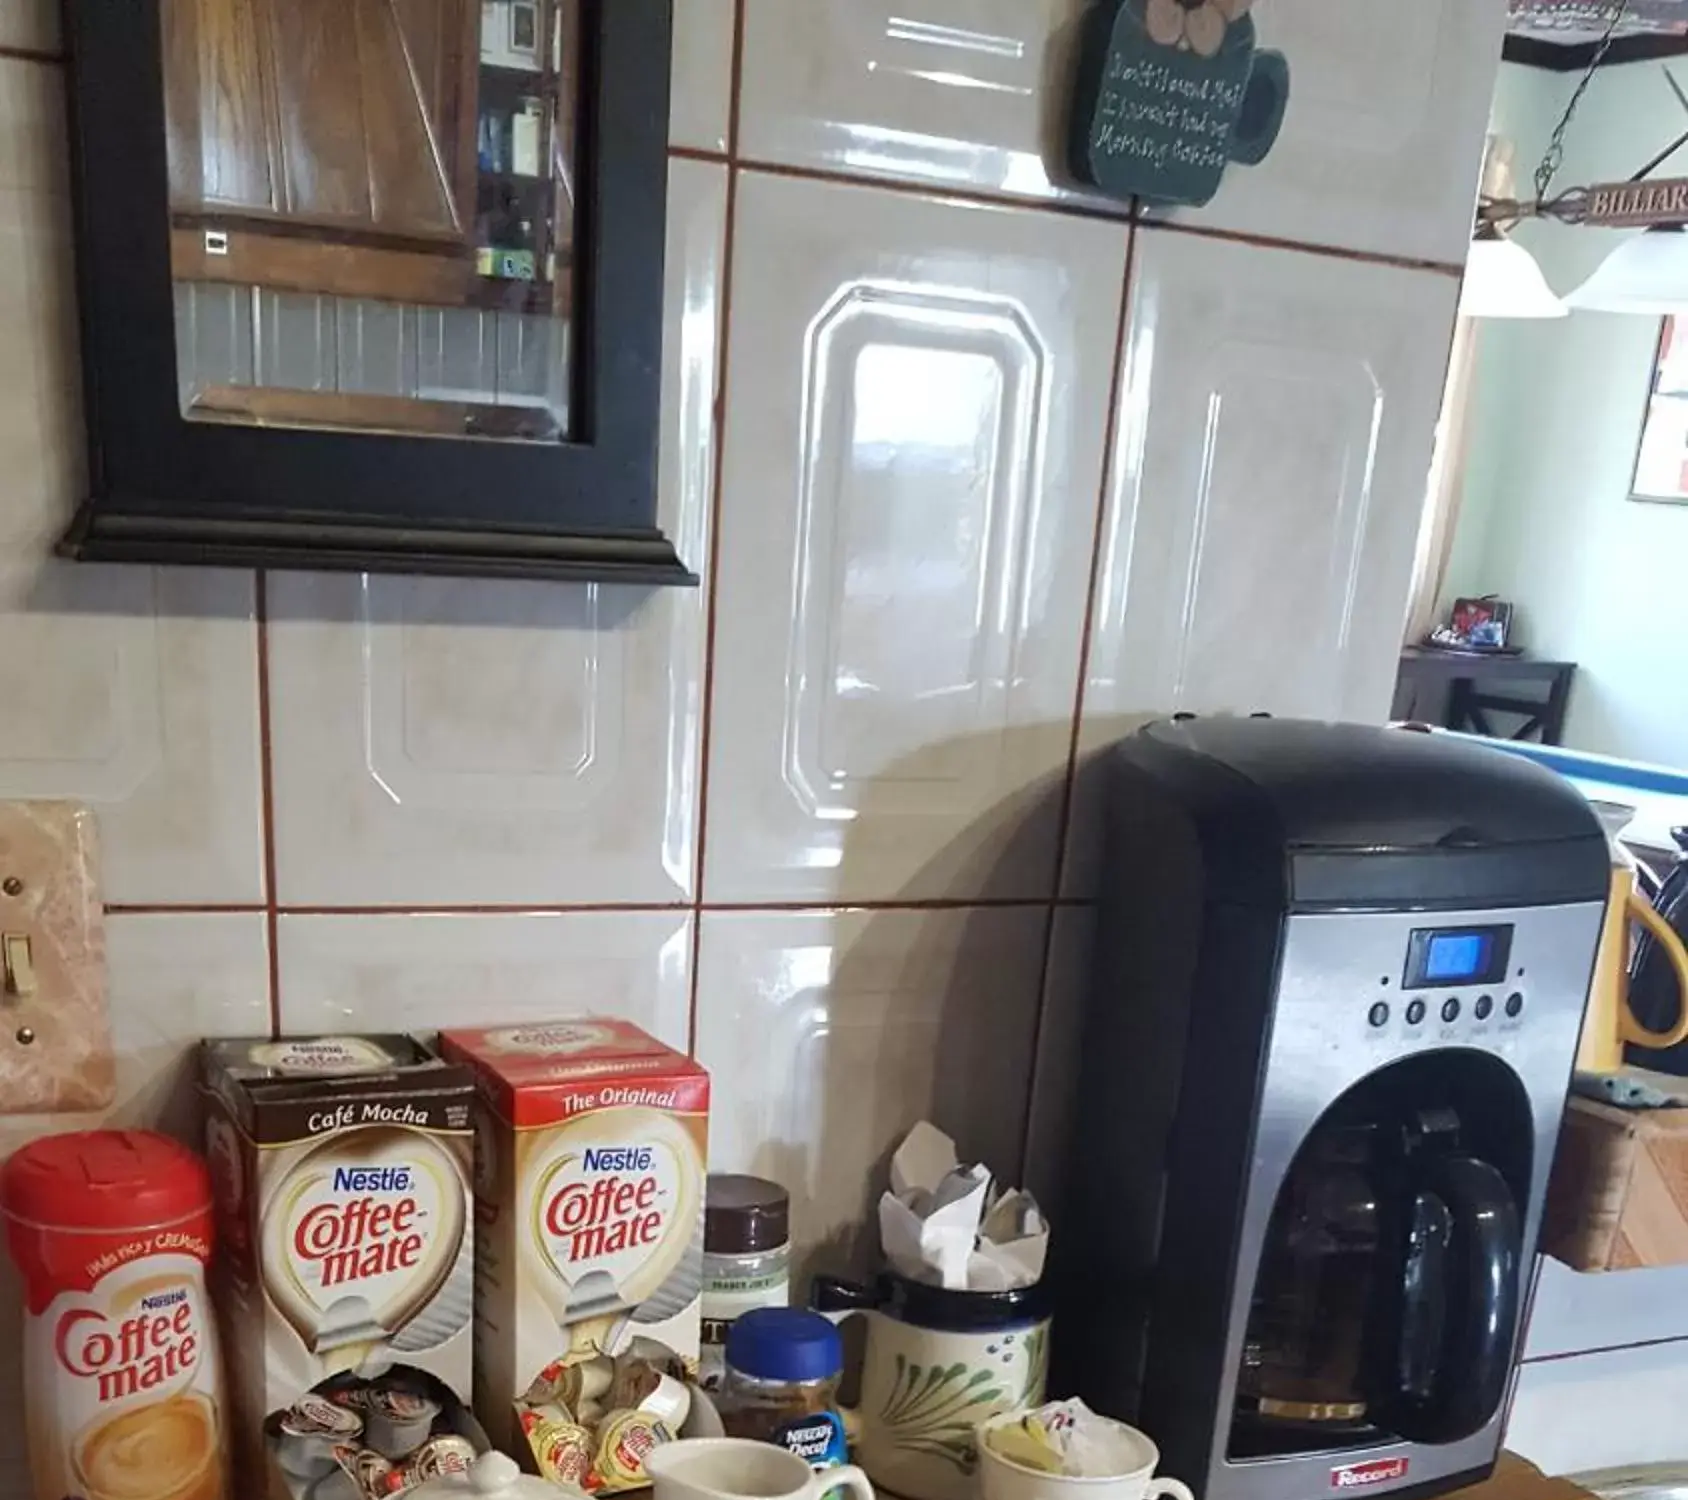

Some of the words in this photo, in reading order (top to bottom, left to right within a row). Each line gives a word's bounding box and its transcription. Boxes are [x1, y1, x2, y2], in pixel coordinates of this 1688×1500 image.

[1102, 90, 1117, 115] I
[1095, 124, 1169, 168] Morning
[563, 1093, 595, 1115] The
[599, 1086, 677, 1108] Original
[308, 1104, 354, 1131] Café
[361, 1103, 428, 1124] Mocha
[583, 1147, 652, 1172] Nestlé
[333, 1167, 410, 1192] Nestlé
[568, 1211, 661, 1262] mate
[321, 1233, 421, 1287] mate
[55, 1303, 192, 1377] Coffee
[98, 1335, 196, 1402] mate
[1338, 1459, 1404, 1486] Record
